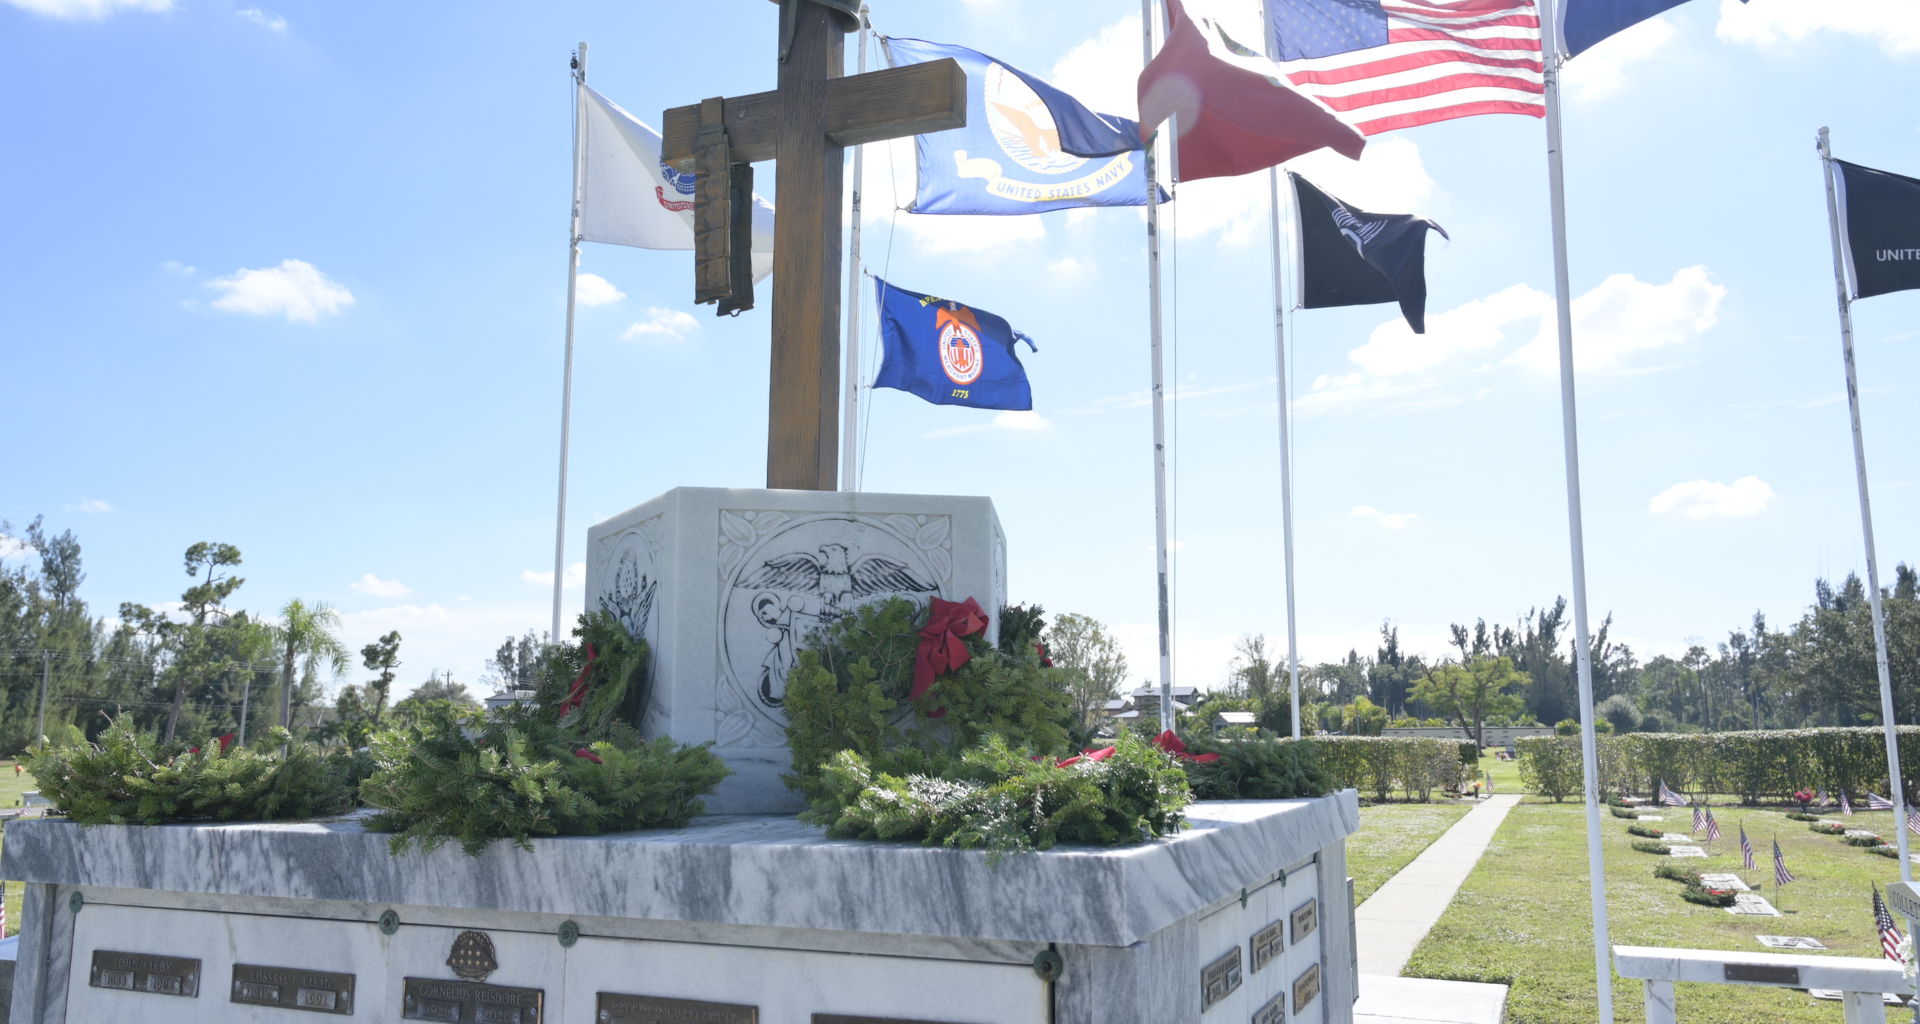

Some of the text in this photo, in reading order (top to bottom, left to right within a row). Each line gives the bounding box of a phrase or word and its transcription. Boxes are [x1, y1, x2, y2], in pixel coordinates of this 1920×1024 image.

[997, 161, 1126, 199] UNITED STATES NAVY
[942, 328, 979, 353] UNITED STATES
[943, 355, 980, 380] MERCHANT MARINE
[951, 389, 969, 399] 1775
[114, 957, 173, 972] JOHN KIRBY
[250, 970, 289, 985] RUSSELL
[303, 976, 334, 988] ELKIN
[305, 992, 327, 1006] 1991
[419, 984, 522, 1006] CORNELIUS REISDORF
[427, 1004, 512, 1022] 1921 2020
[612, 1002, 663, 1016] RAYMOND
